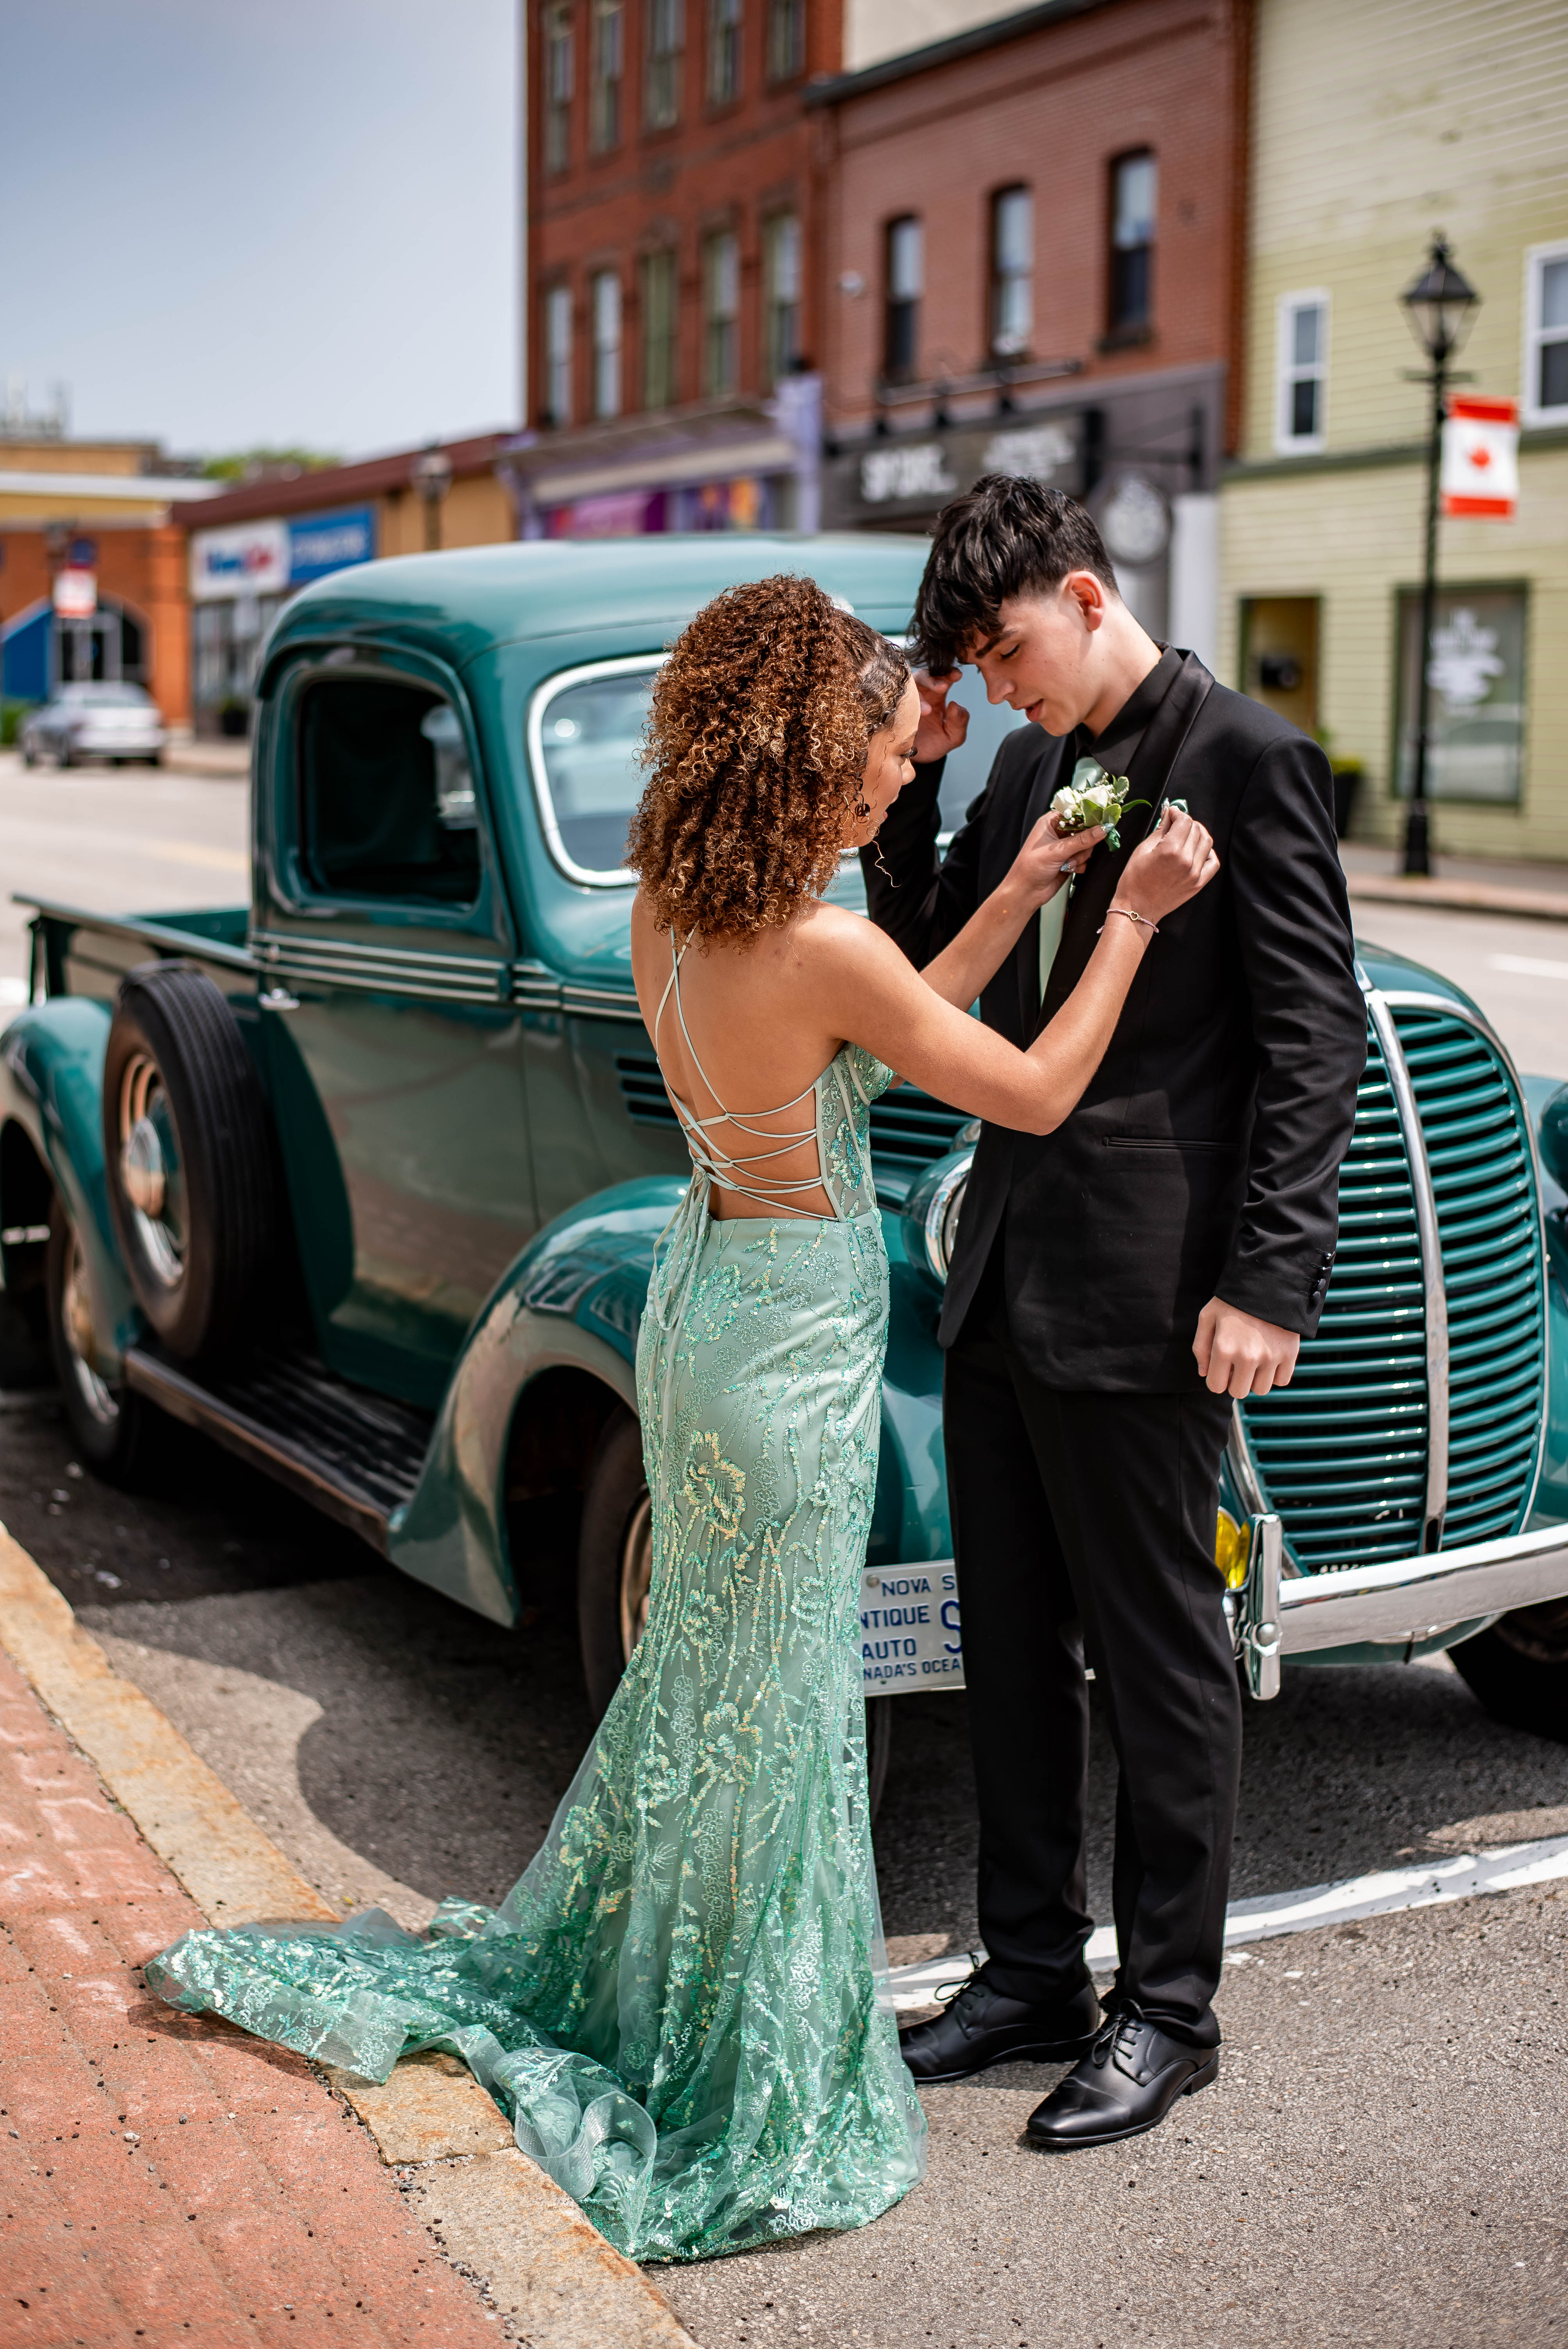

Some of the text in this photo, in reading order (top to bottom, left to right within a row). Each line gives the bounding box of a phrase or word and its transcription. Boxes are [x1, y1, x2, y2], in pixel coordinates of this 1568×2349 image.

[882, 1575, 955, 1597] NOVA S
[861, 1604, 930, 1629] NTIQUE
[862, 1638, 916, 1660] AUTO
[863, 1657, 961, 1680] NADA'S OCEA
